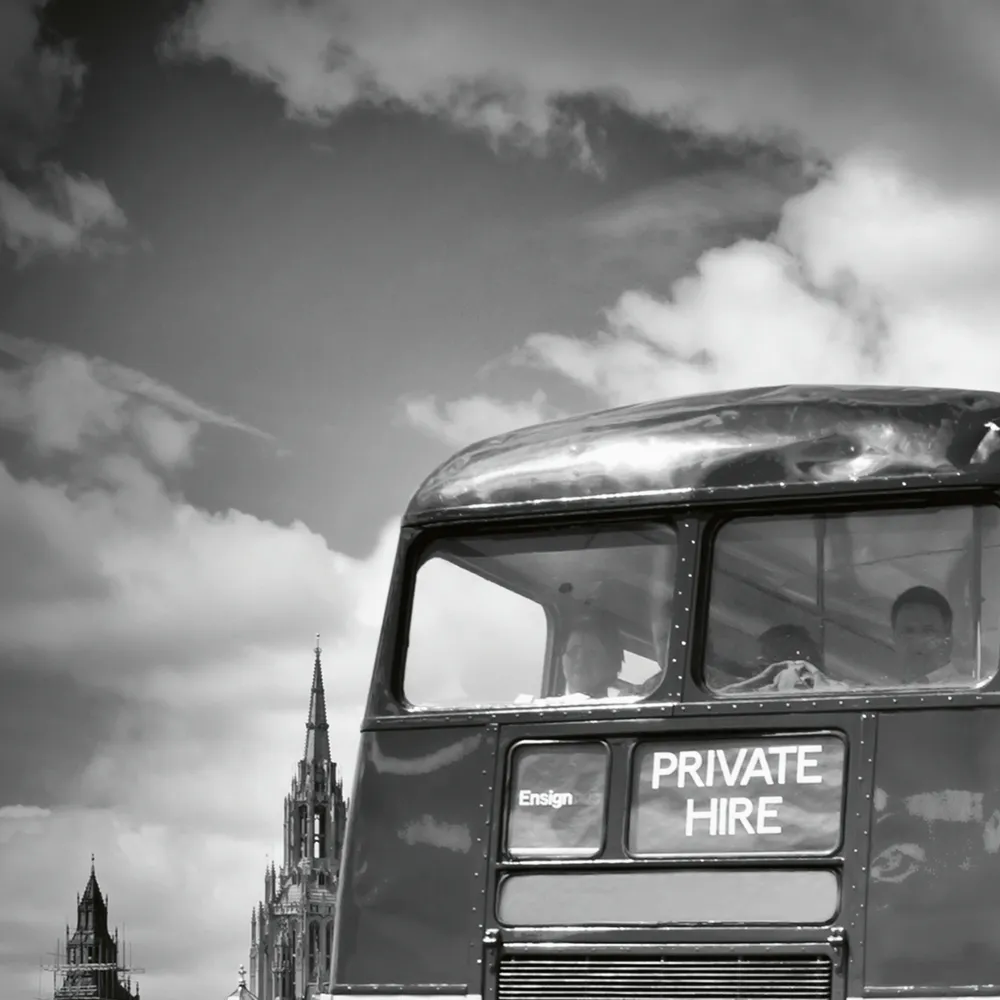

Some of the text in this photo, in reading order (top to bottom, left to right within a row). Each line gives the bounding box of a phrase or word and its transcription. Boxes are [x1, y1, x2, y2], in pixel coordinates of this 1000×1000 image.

[652, 745, 822, 789] PRIVATE
[518, 790, 573, 809] Ensign
[685, 796, 783, 836] HIRE
